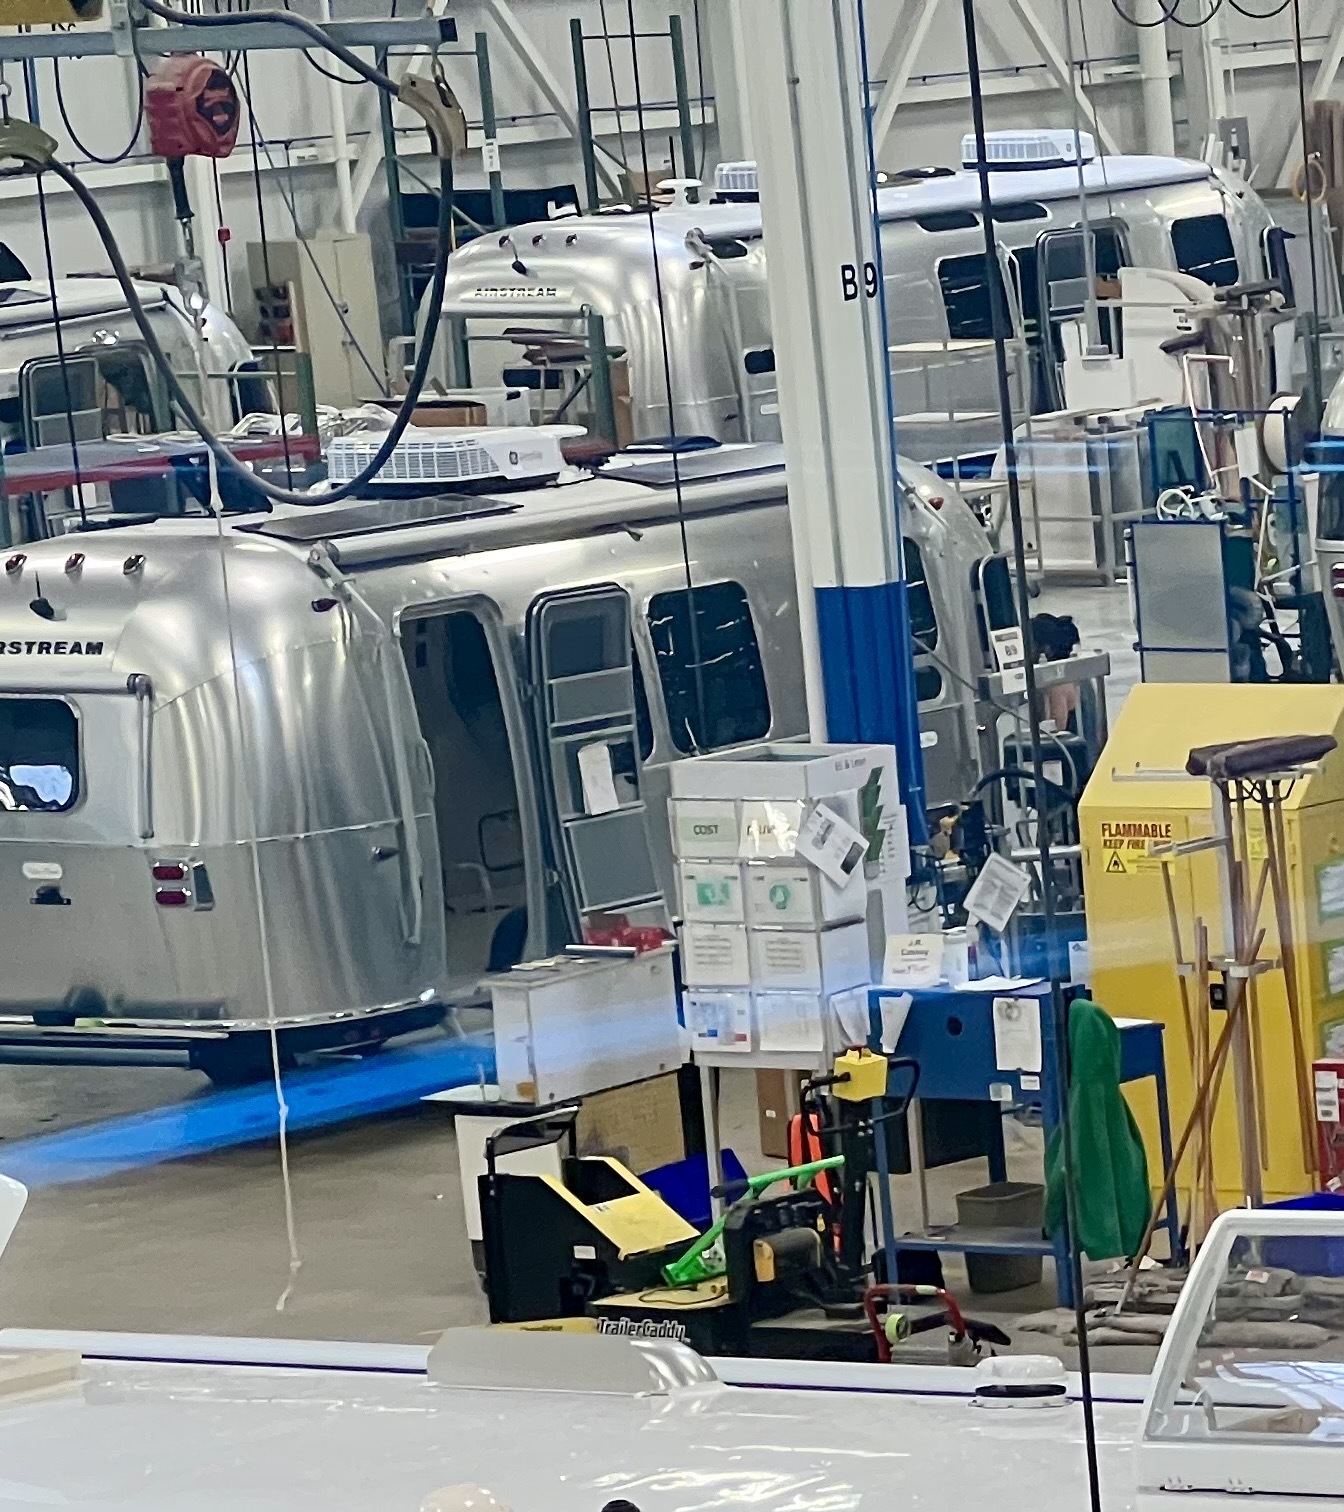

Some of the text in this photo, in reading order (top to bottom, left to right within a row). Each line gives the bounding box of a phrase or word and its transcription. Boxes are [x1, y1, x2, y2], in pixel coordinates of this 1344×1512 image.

[841, 262, 878, 301] B9
[475, 287, 557, 298] AIRSTREAM
[1101, 823, 1172, 838] FLAMMABLE
